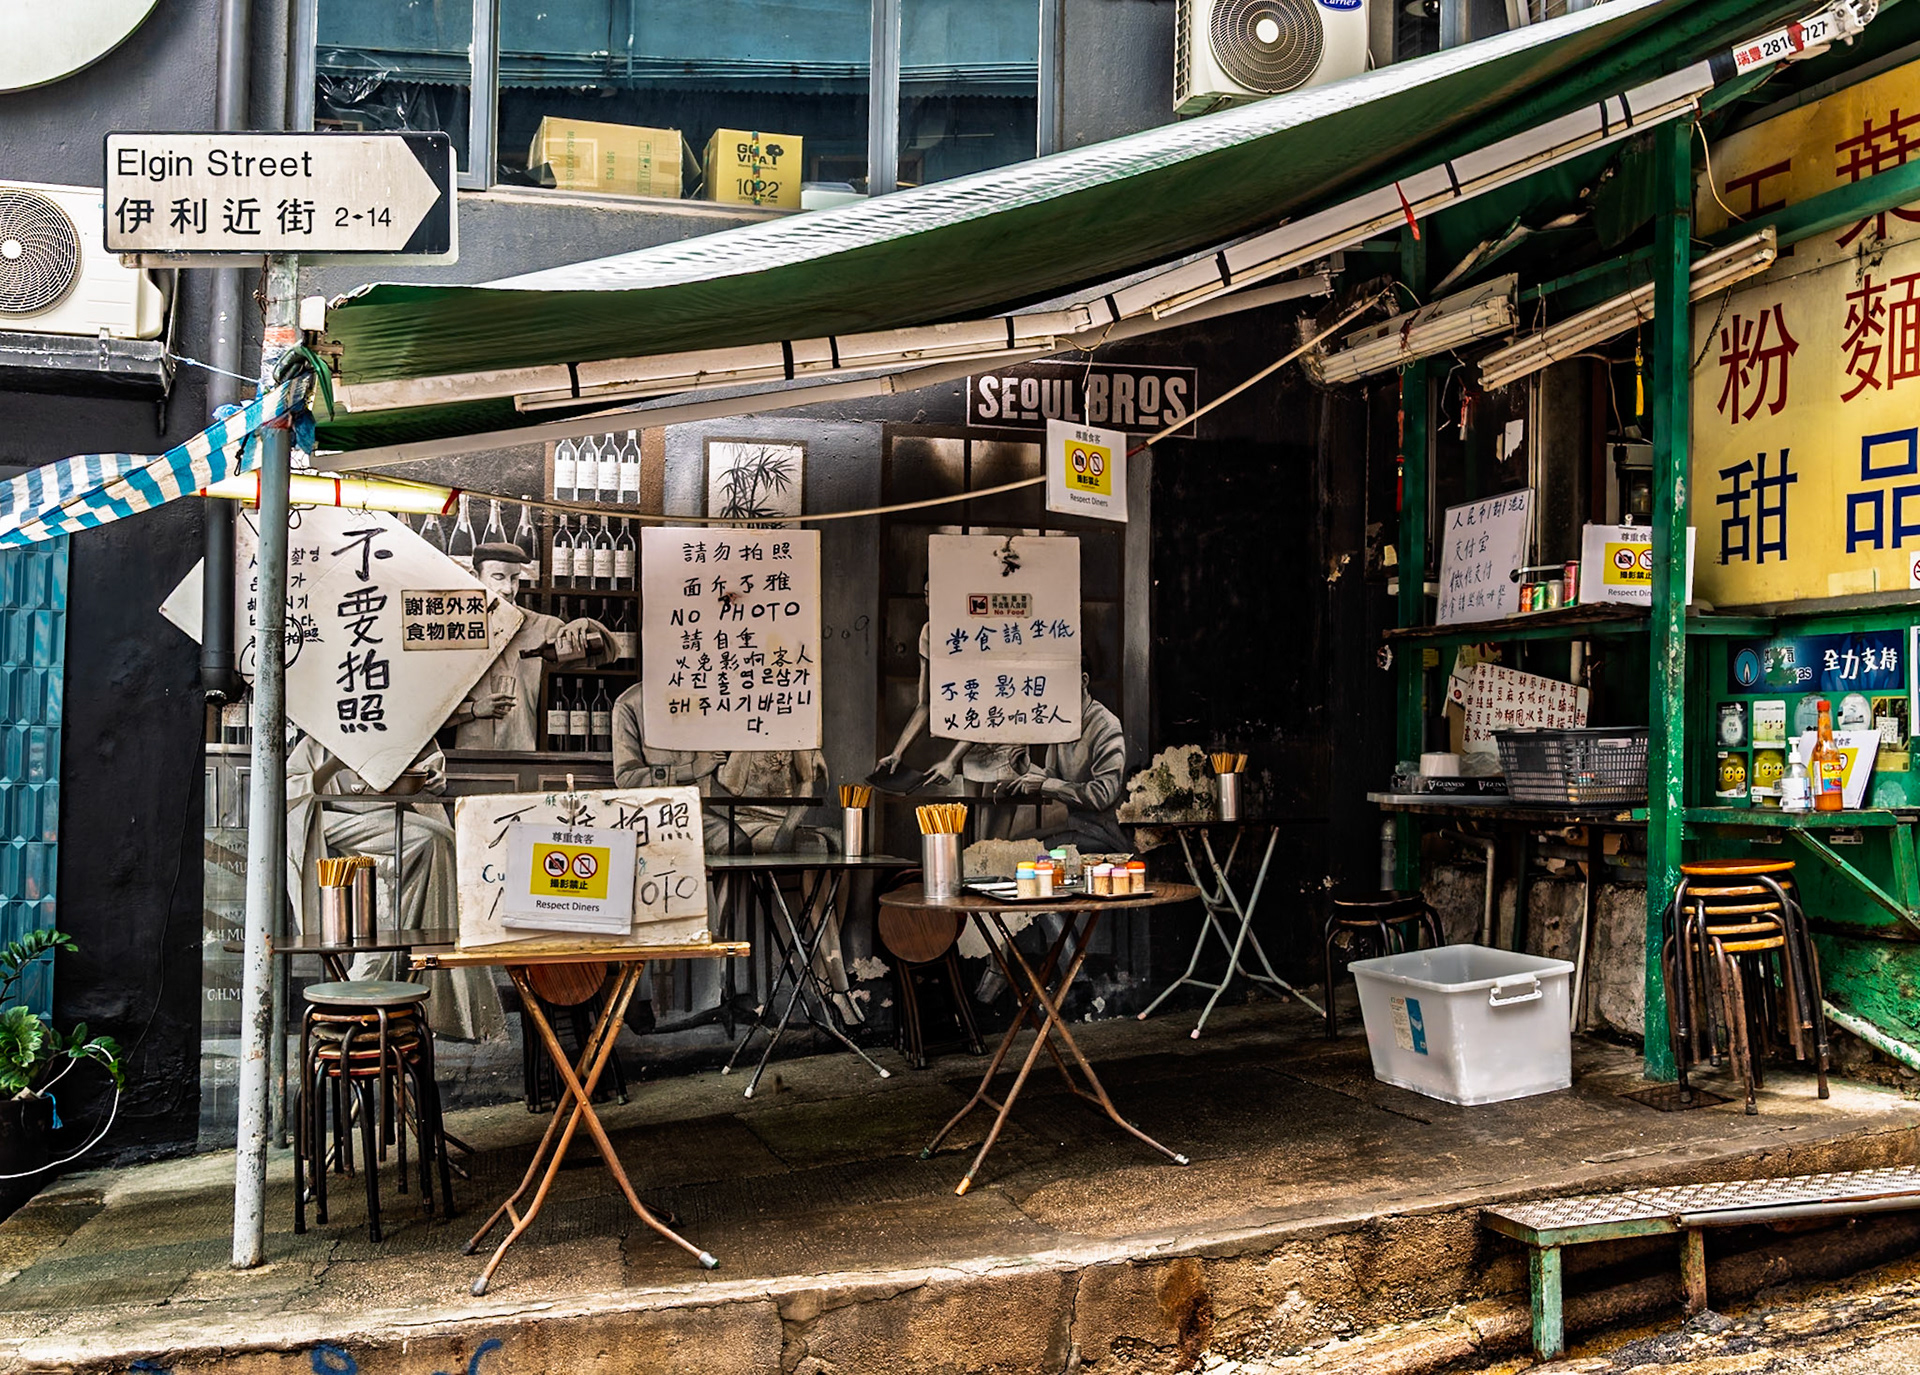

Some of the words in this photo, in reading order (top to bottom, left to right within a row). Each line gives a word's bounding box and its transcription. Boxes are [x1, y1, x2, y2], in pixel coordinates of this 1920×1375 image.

[117, 148, 193, 182] Elgin
[207, 149, 312, 177] Street
[115, 196, 315, 235] 伊利近街
[978, 375, 1080, 421] SEOUL
[1088, 373, 1187, 426] BROS
[1070, 493, 1091, 505] Respect
[1092, 497, 1108, 507] Diners
[1716, 427, 1920, 567] 甜品
[682, 542, 793, 563] 請勿拍照
[683, 571, 792, 597] 面斥不雅
[1608, 588, 1637, 597] Respect
[1639, 589, 1652, 597] Din
[404, 596, 486, 617] 謝絕外來
[670, 608, 701, 626] NO
[718, 601, 801, 622] PHOTO
[331, 528, 393, 734] 不要拍照
[405, 622, 486, 641] 食物飲品
[680, 627, 758, 652] 請自重
[946, 619, 1075, 655] 堂食請坐低
[1823, 647, 1898, 680] 全力支持
[941, 675, 1047, 702] 不要影相
[1436, 780, 1466, 788] GUINNESS
[552, 832, 595, 845] 尊重食客
[536, 900, 570, 911] Respect
[572, 902, 600, 912] Diners
